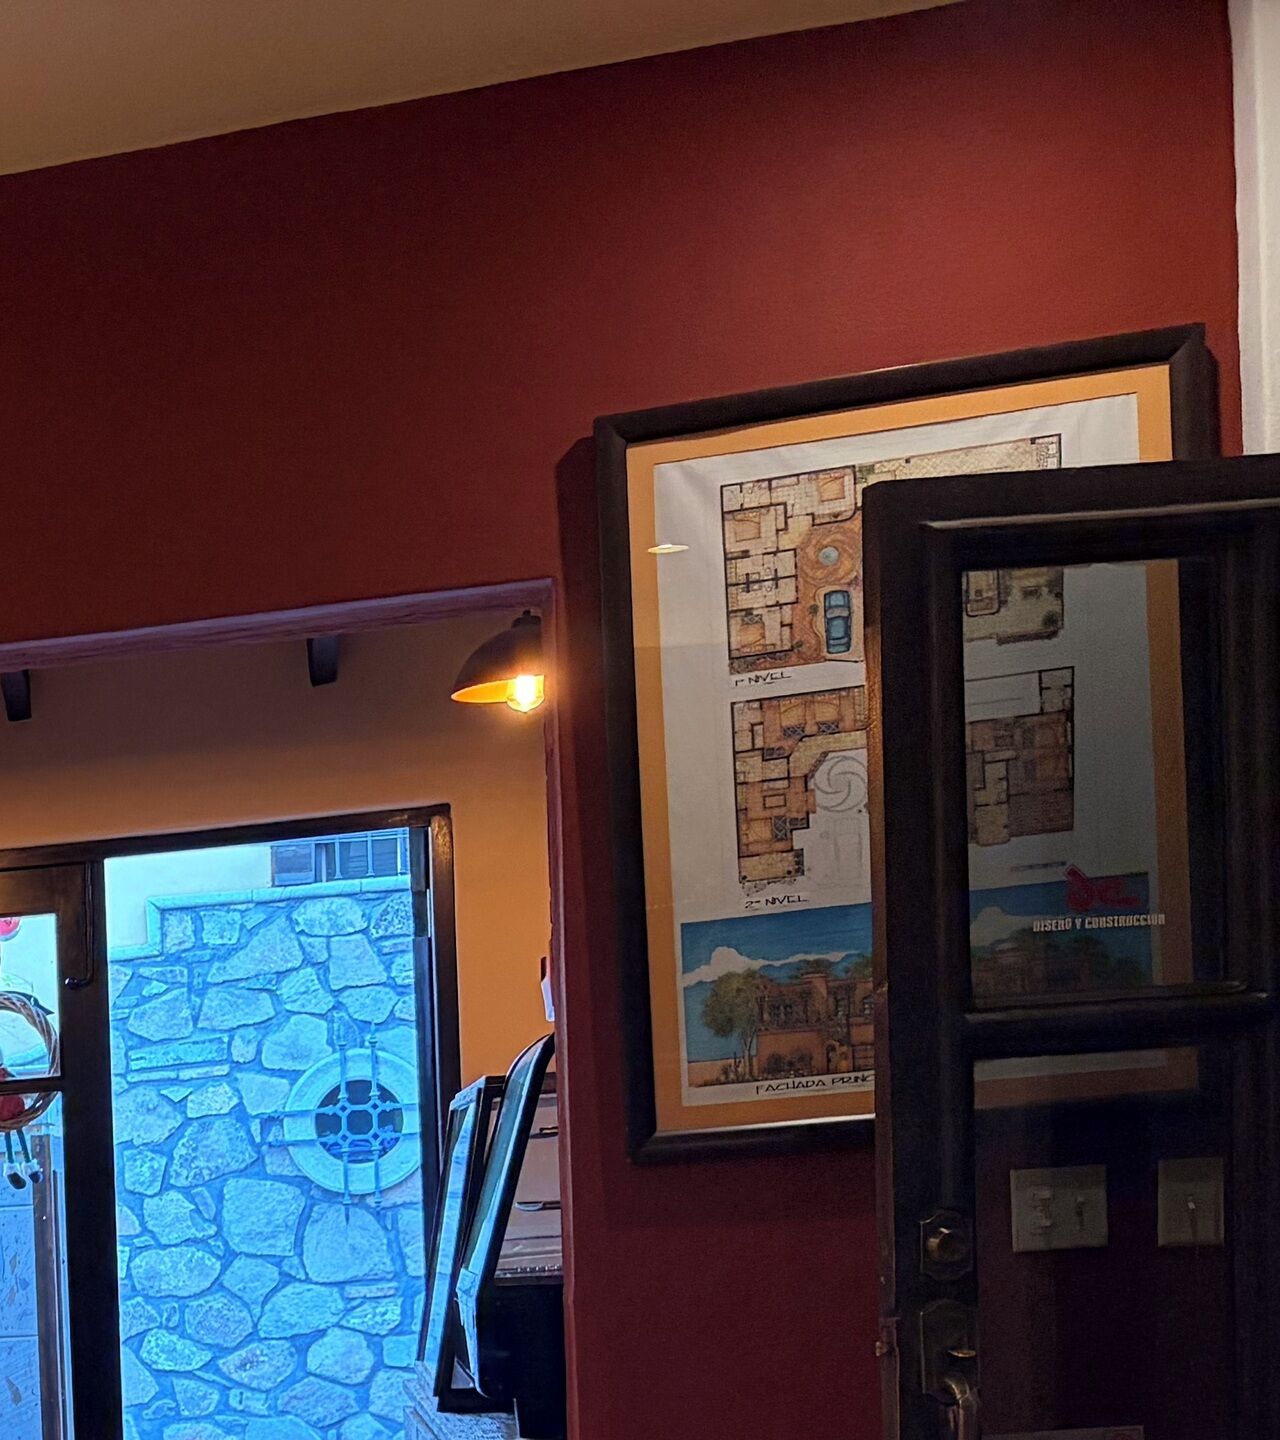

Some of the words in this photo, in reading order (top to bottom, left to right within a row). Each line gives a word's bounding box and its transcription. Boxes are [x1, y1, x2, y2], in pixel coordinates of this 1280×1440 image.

[748, 671, 792, 684] NIVEL
[765, 895, 809, 906] NIVEL
[1074, 918, 1082, 930] Y
